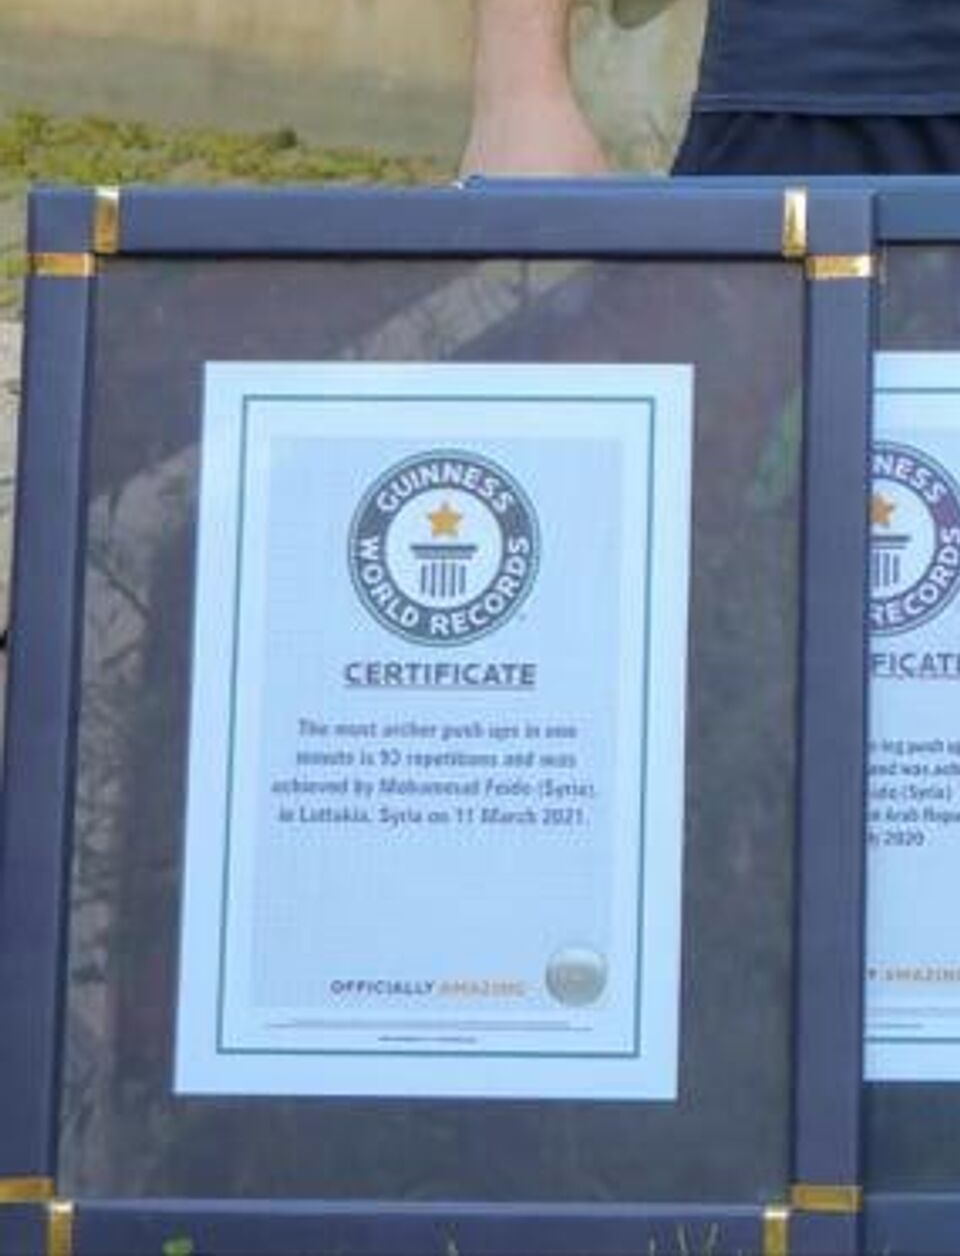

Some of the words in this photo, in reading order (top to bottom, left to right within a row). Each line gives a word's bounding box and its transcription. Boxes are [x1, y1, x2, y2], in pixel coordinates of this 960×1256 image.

[376, 460, 515, 513] GUINNESS
[870, 454, 949, 504] NESS
[359, 534, 420, 628] WORLD
[429, 535, 530, 636] RECORDS
[343, 661, 538, 686] CERTIFICATE
[299, 719, 328, 738] The
[334, 722, 377, 738] most
[383, 720, 436, 739] archer
[441, 721, 482, 742] push
[489, 725, 519, 741] ups
[525, 723, 540, 738] in
[546, 726, 577, 739] one
[297, 750, 354, 766] minute
[360, 749, 375, 766] is
[406, 749, 498, 770] repetitions
[503, 751, 534, 768] and
[540, 754, 577, 768] was
[900, 764, 929, 777] was
[271, 777, 348, 794] achieved
[354, 778, 374, 799] by
[379, 807, 422, 827] Syria
[427, 811, 449, 823] on
[481, 807, 538, 824] March
[885, 805, 920, 823] Arab
[329, 979, 435, 996] OFFICIALLY
